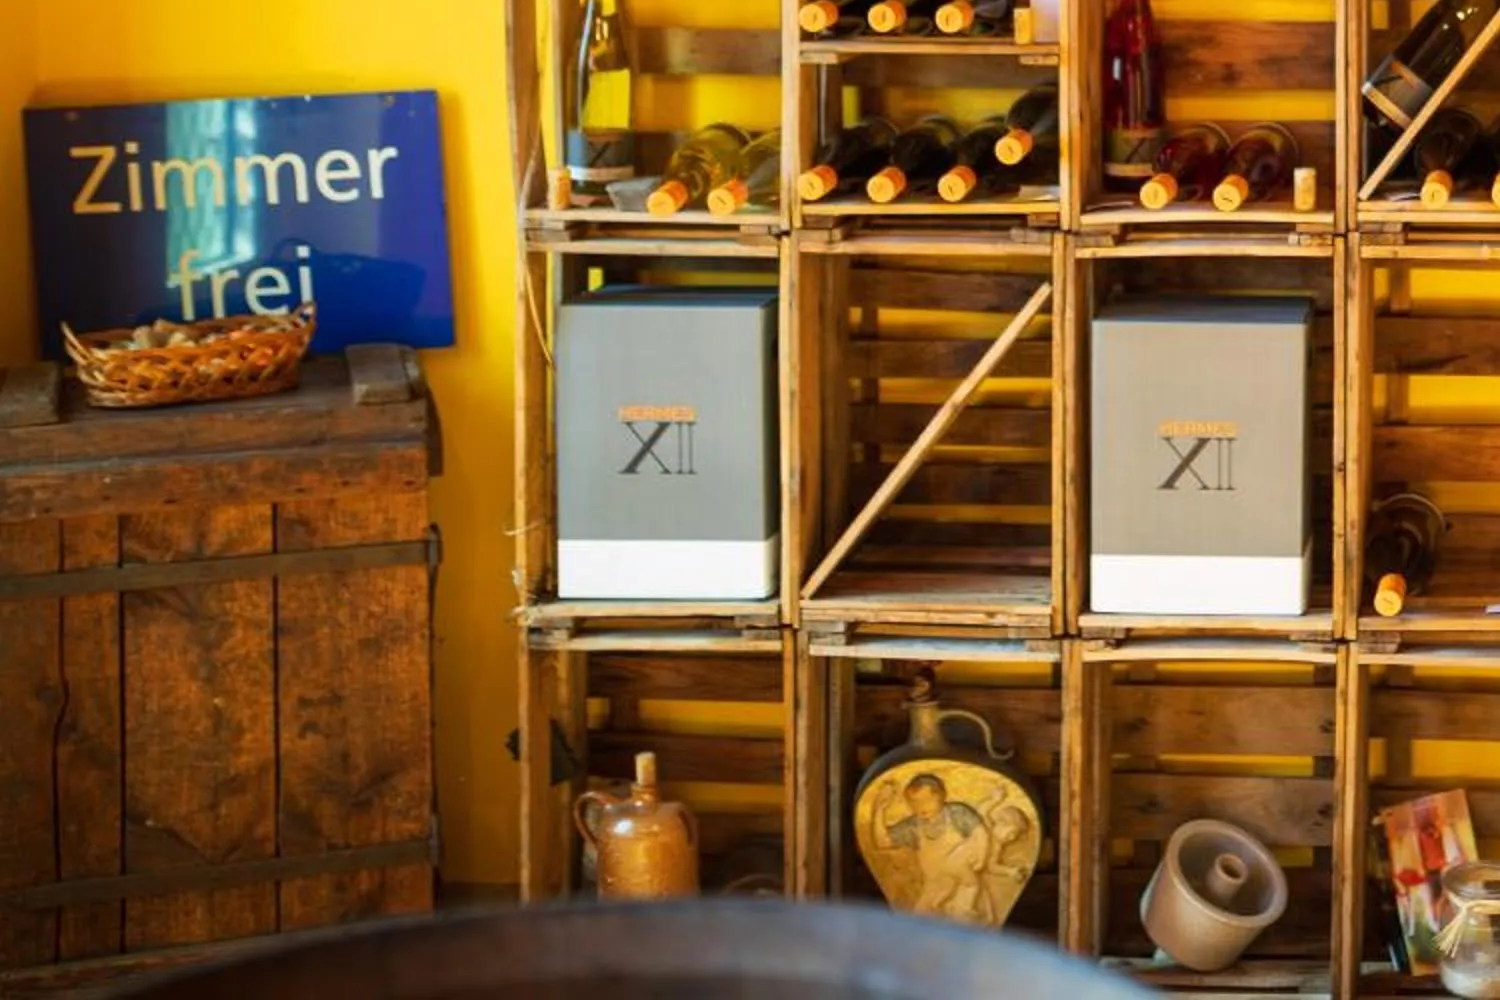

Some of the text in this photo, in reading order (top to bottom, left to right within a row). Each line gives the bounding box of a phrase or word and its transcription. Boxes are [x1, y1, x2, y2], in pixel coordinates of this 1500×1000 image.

[69, 141, 398, 214] Zimmer
[167, 246, 314, 322] frei
[618, 421, 698, 475] XII
[1157, 437, 1237, 490] XII
